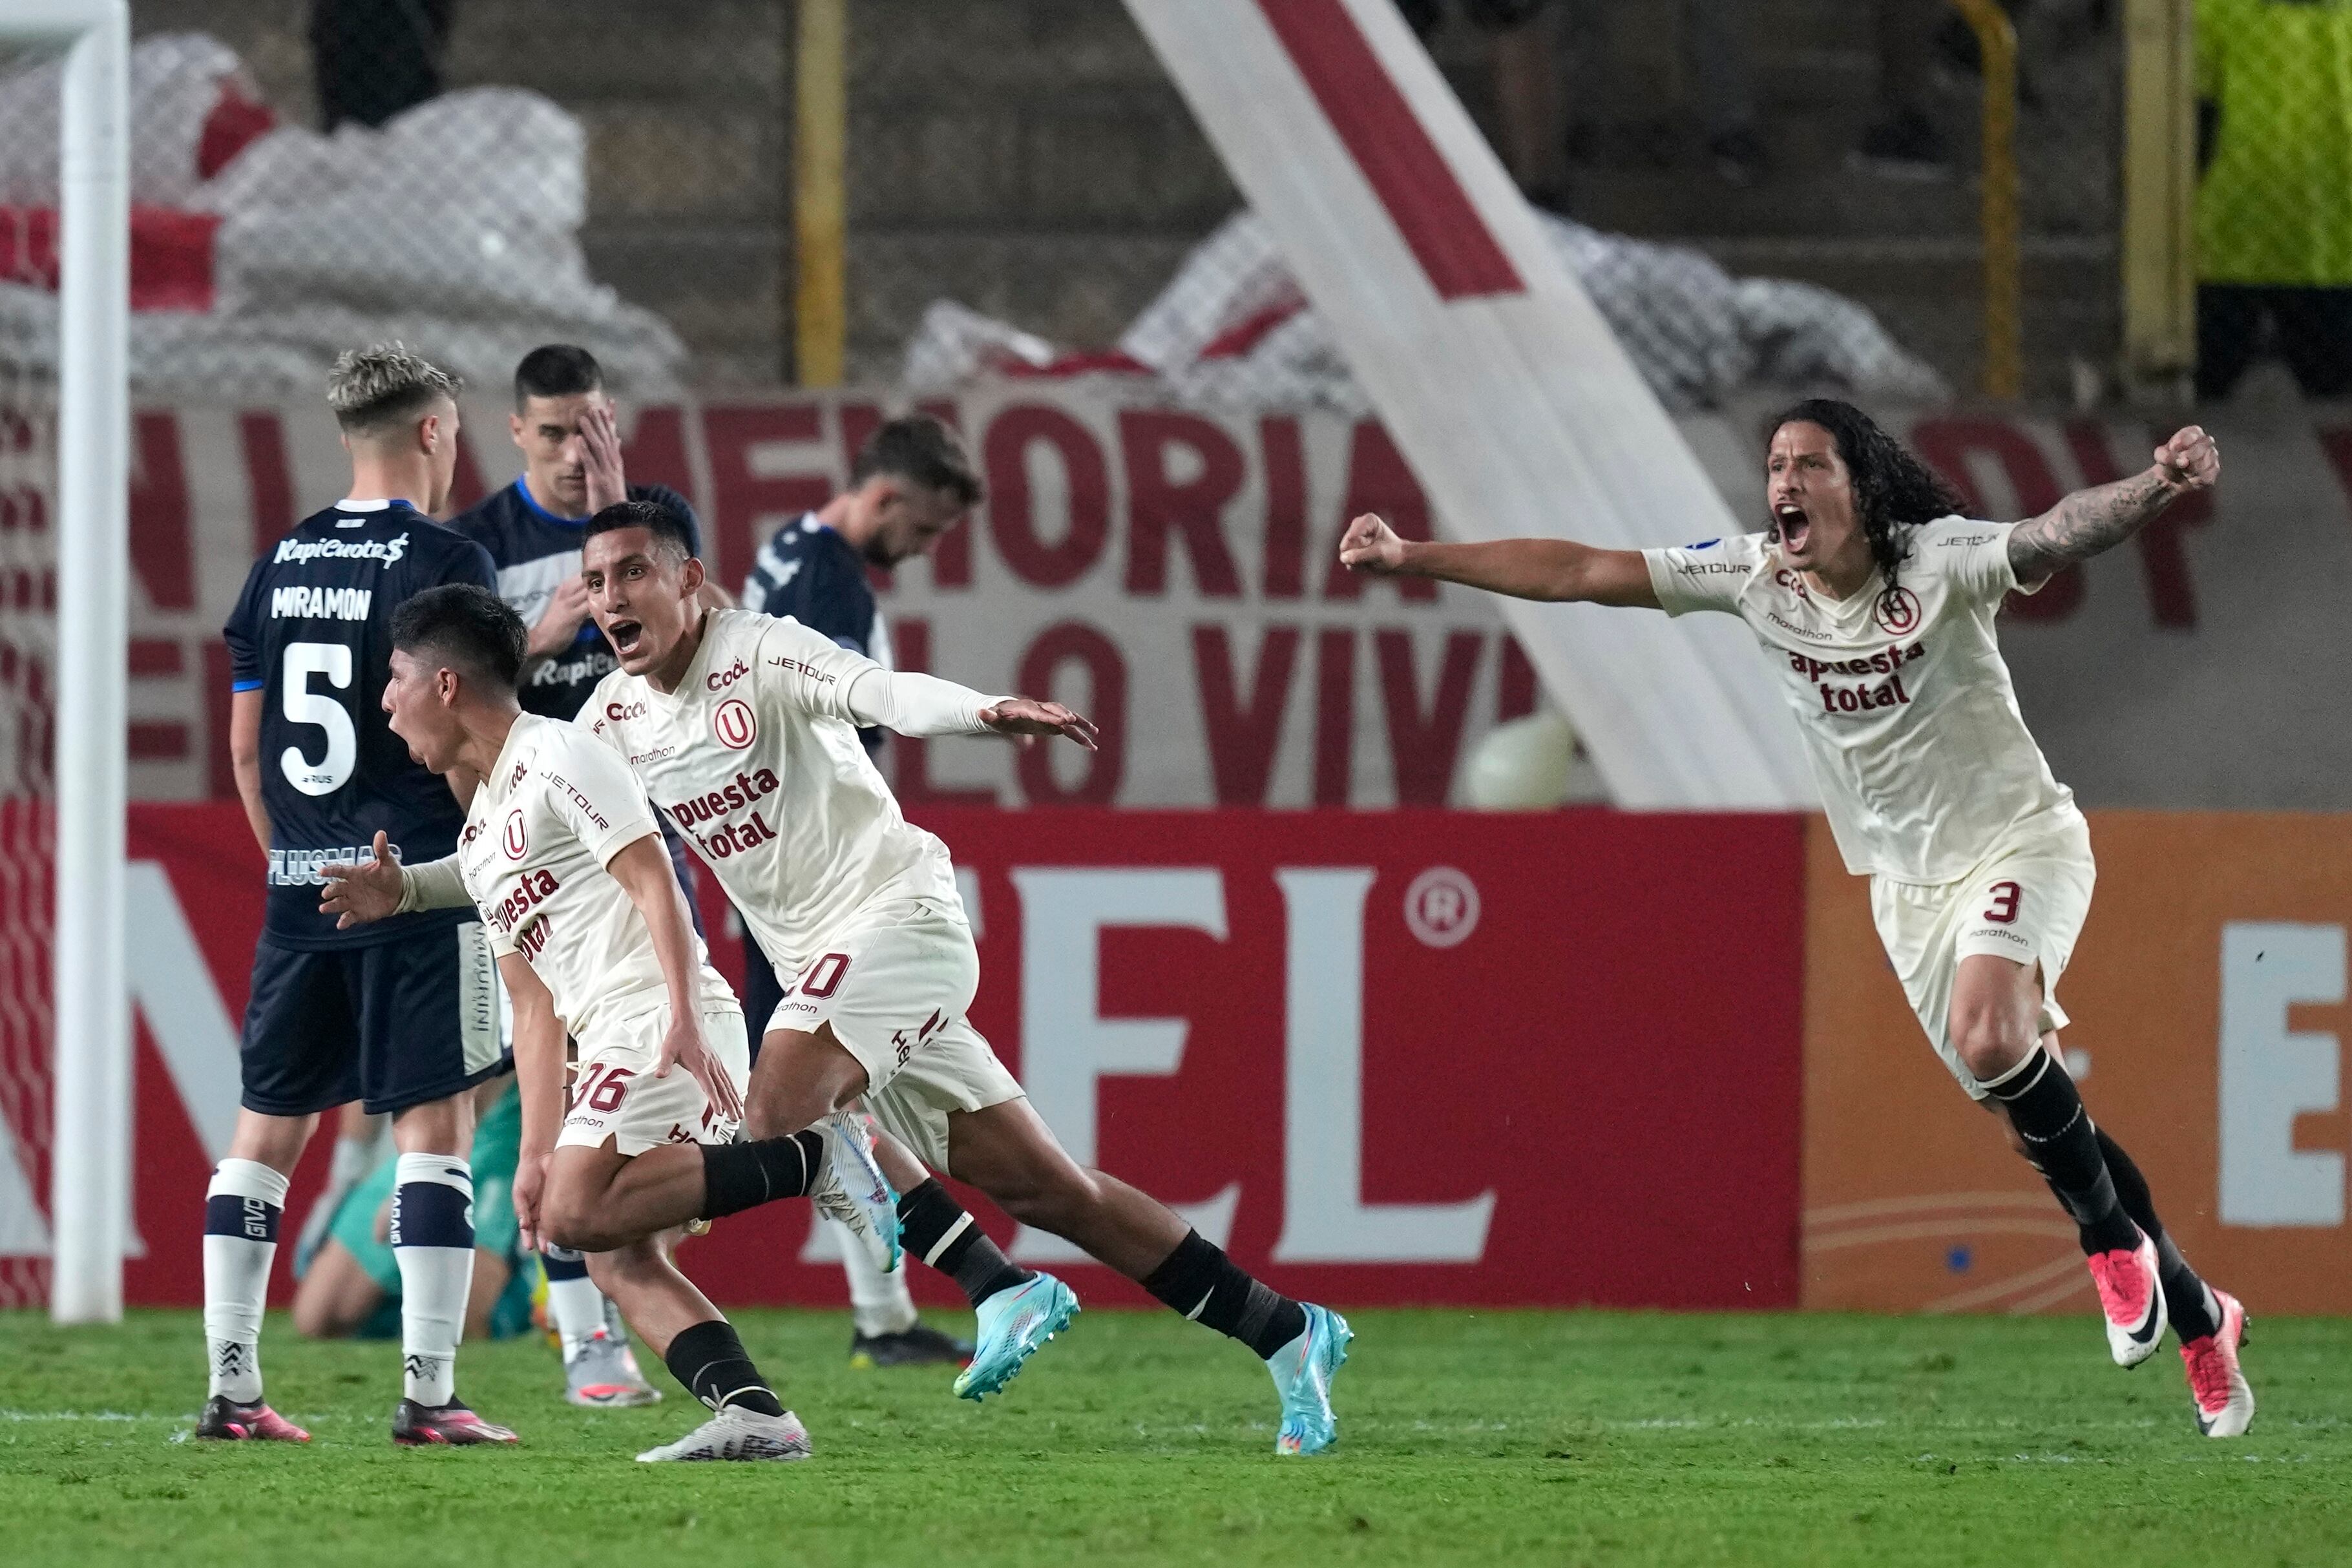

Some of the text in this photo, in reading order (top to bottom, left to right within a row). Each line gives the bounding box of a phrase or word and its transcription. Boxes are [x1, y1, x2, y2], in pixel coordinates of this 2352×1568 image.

[271, 586, 372, 621] MIRAMON
[1767, 612, 1833, 641] marathon
[768, 656, 837, 687] JETOUR
[1820, 674, 1911, 712] total
[280, 642, 357, 797] 5
[540, 771, 609, 831] JETOUR
[1983, 881, 2022, 926] 3
